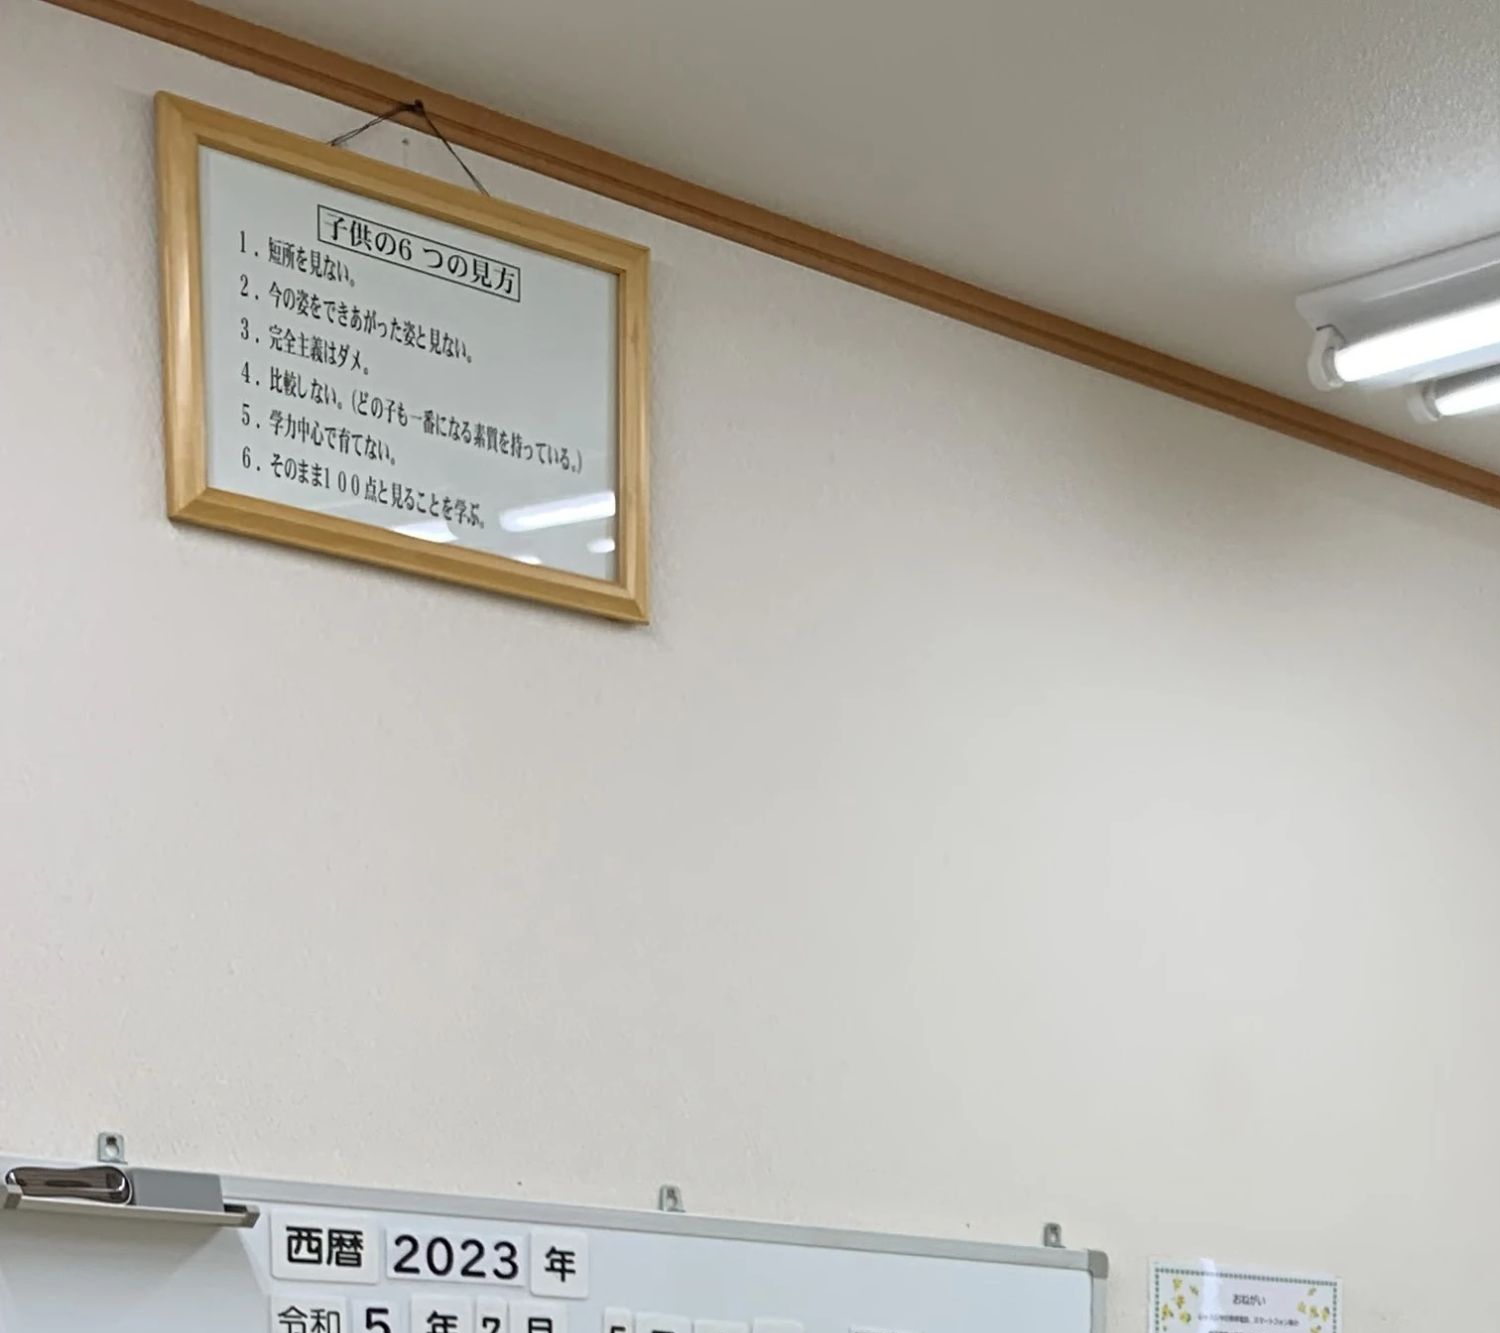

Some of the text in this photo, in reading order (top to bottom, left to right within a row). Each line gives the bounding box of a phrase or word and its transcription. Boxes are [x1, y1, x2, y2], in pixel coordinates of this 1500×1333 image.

[323, 213, 516, 296] 子供の6つの見方
[286, 1225, 577, 1283] 西暦 2023 年
[1232, 1294, 1266, 1306] おねがい
